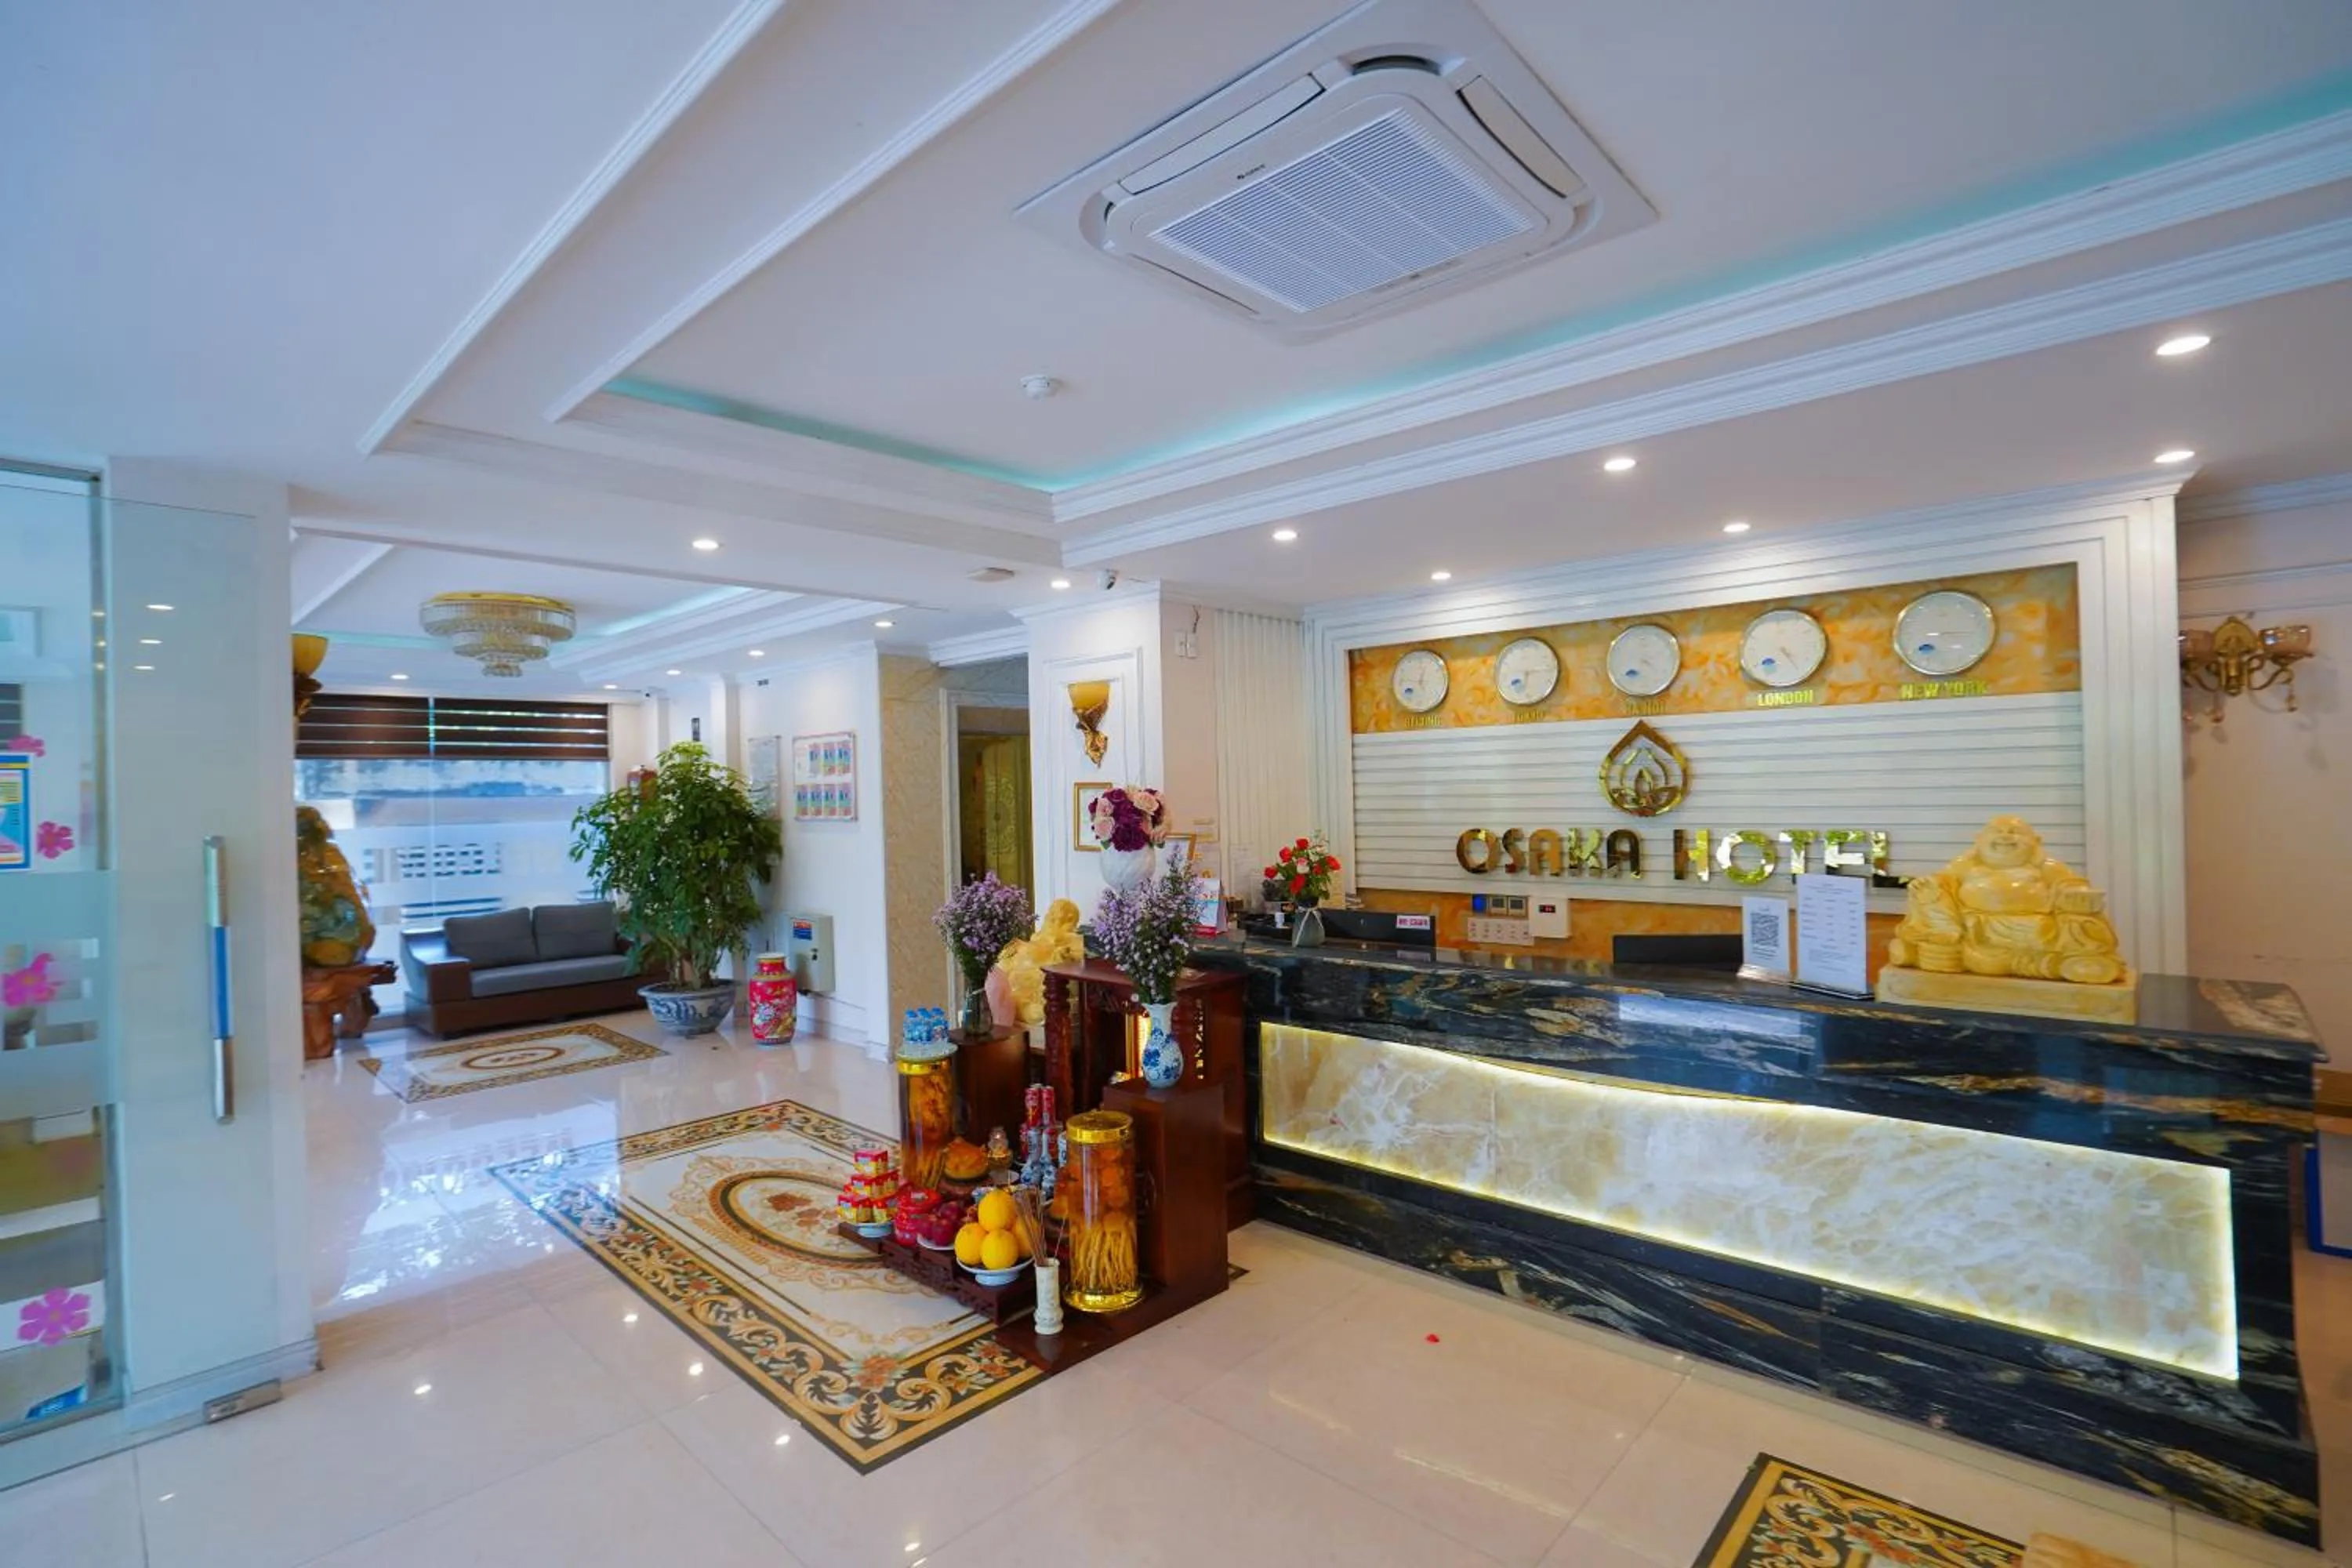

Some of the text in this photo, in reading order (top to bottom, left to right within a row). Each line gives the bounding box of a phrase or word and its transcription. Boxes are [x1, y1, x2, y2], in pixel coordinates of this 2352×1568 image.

[1757, 689, 1814, 706] LONDON
[1900, 680, 1989, 699] NEW YORK
[1456, 827, 1909, 887] OSAKA HOTEL
